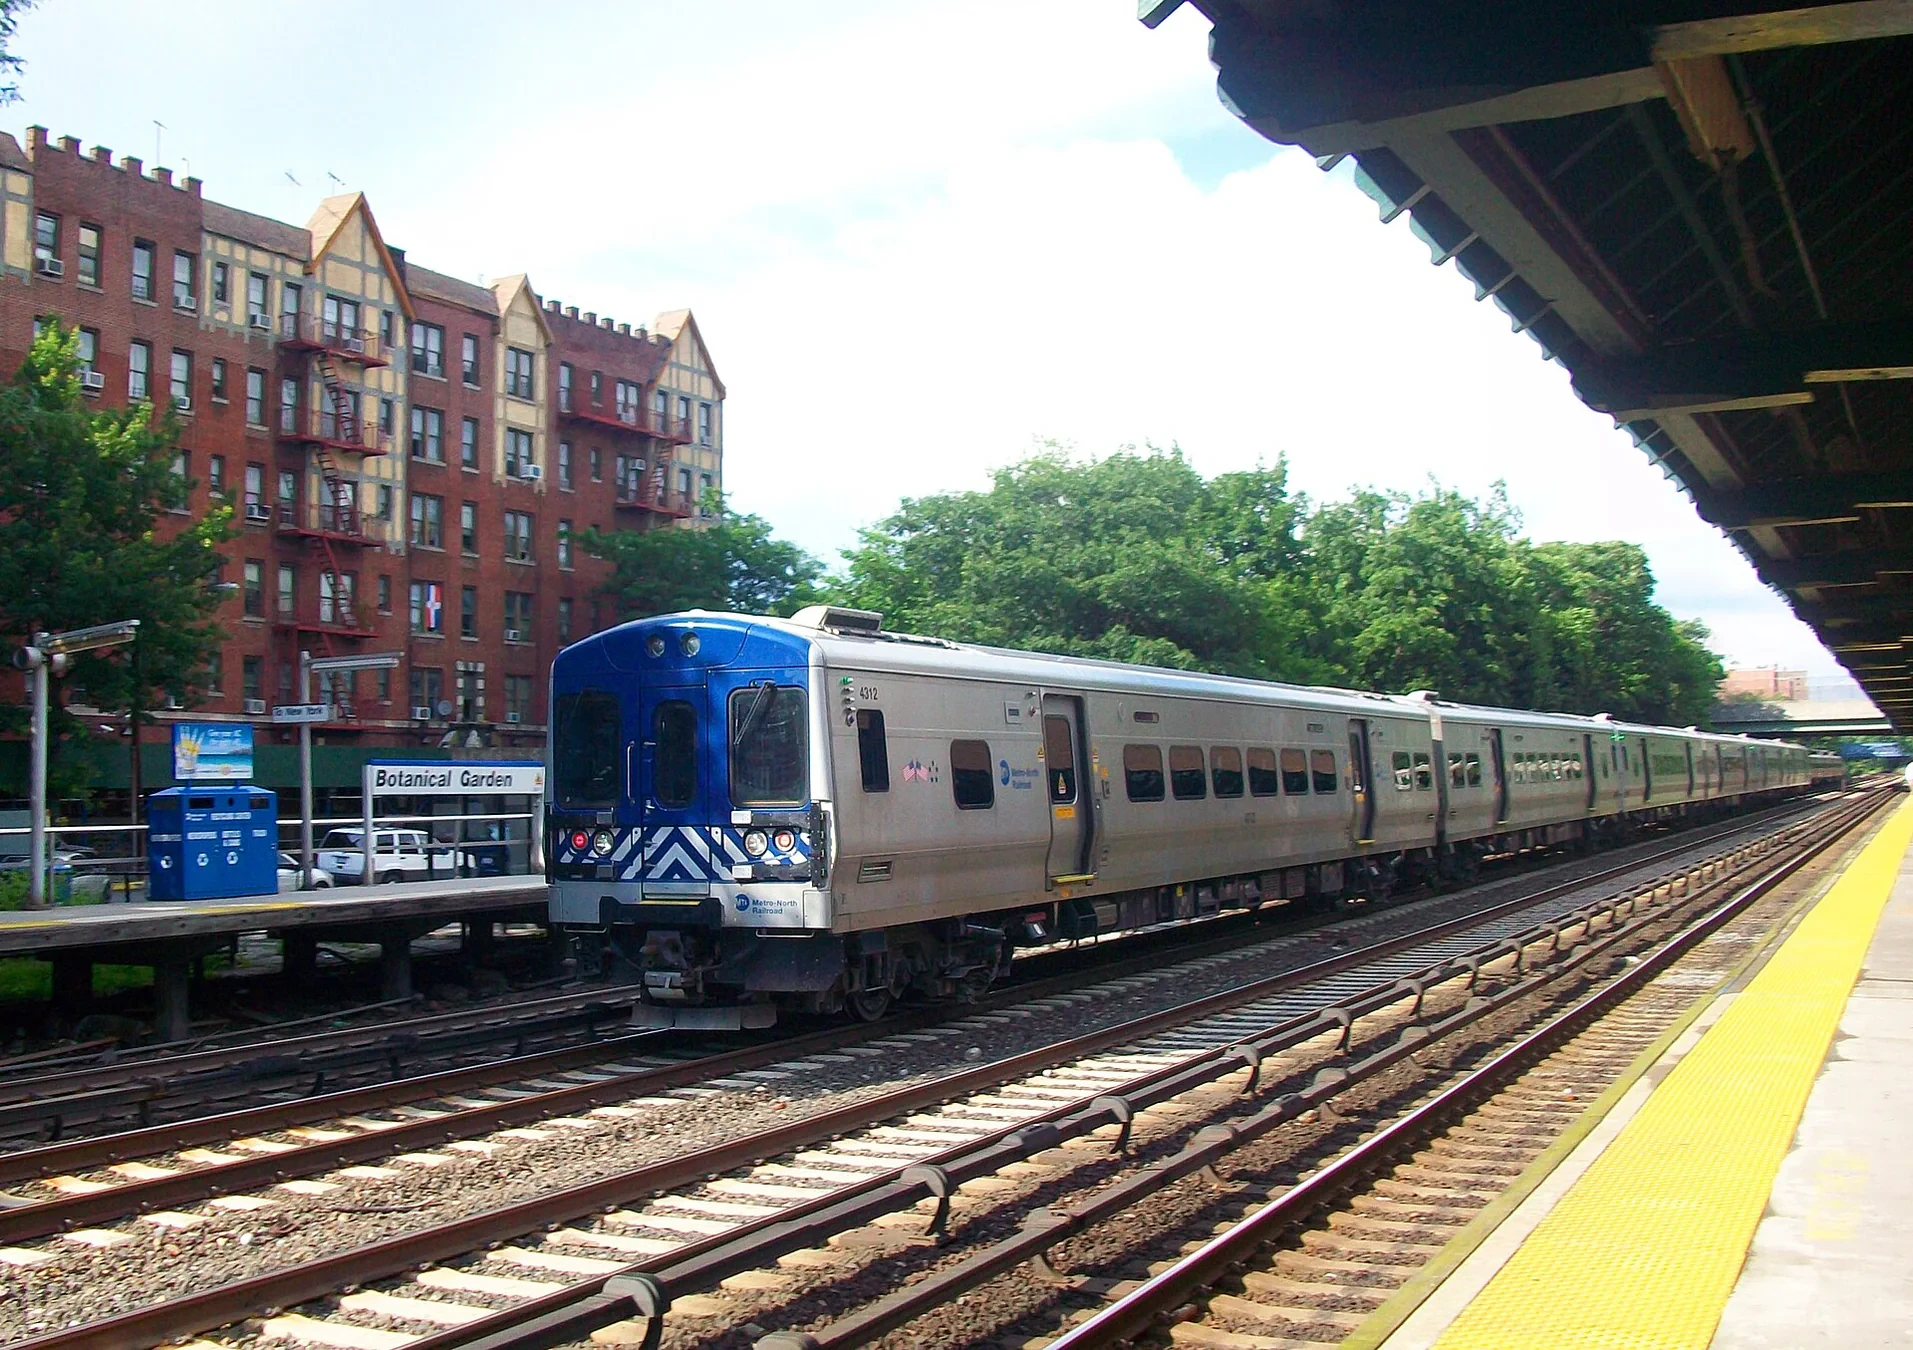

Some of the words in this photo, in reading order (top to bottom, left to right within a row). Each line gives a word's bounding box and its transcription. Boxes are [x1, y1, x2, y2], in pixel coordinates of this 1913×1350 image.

[860, 686, 878, 700] 4312
[376, 769, 452, 787] Botanical
[460, 770, 513, 787] Garden
[752, 899, 798, 907] Metro-North
[752, 907, 783, 915] Railroad
